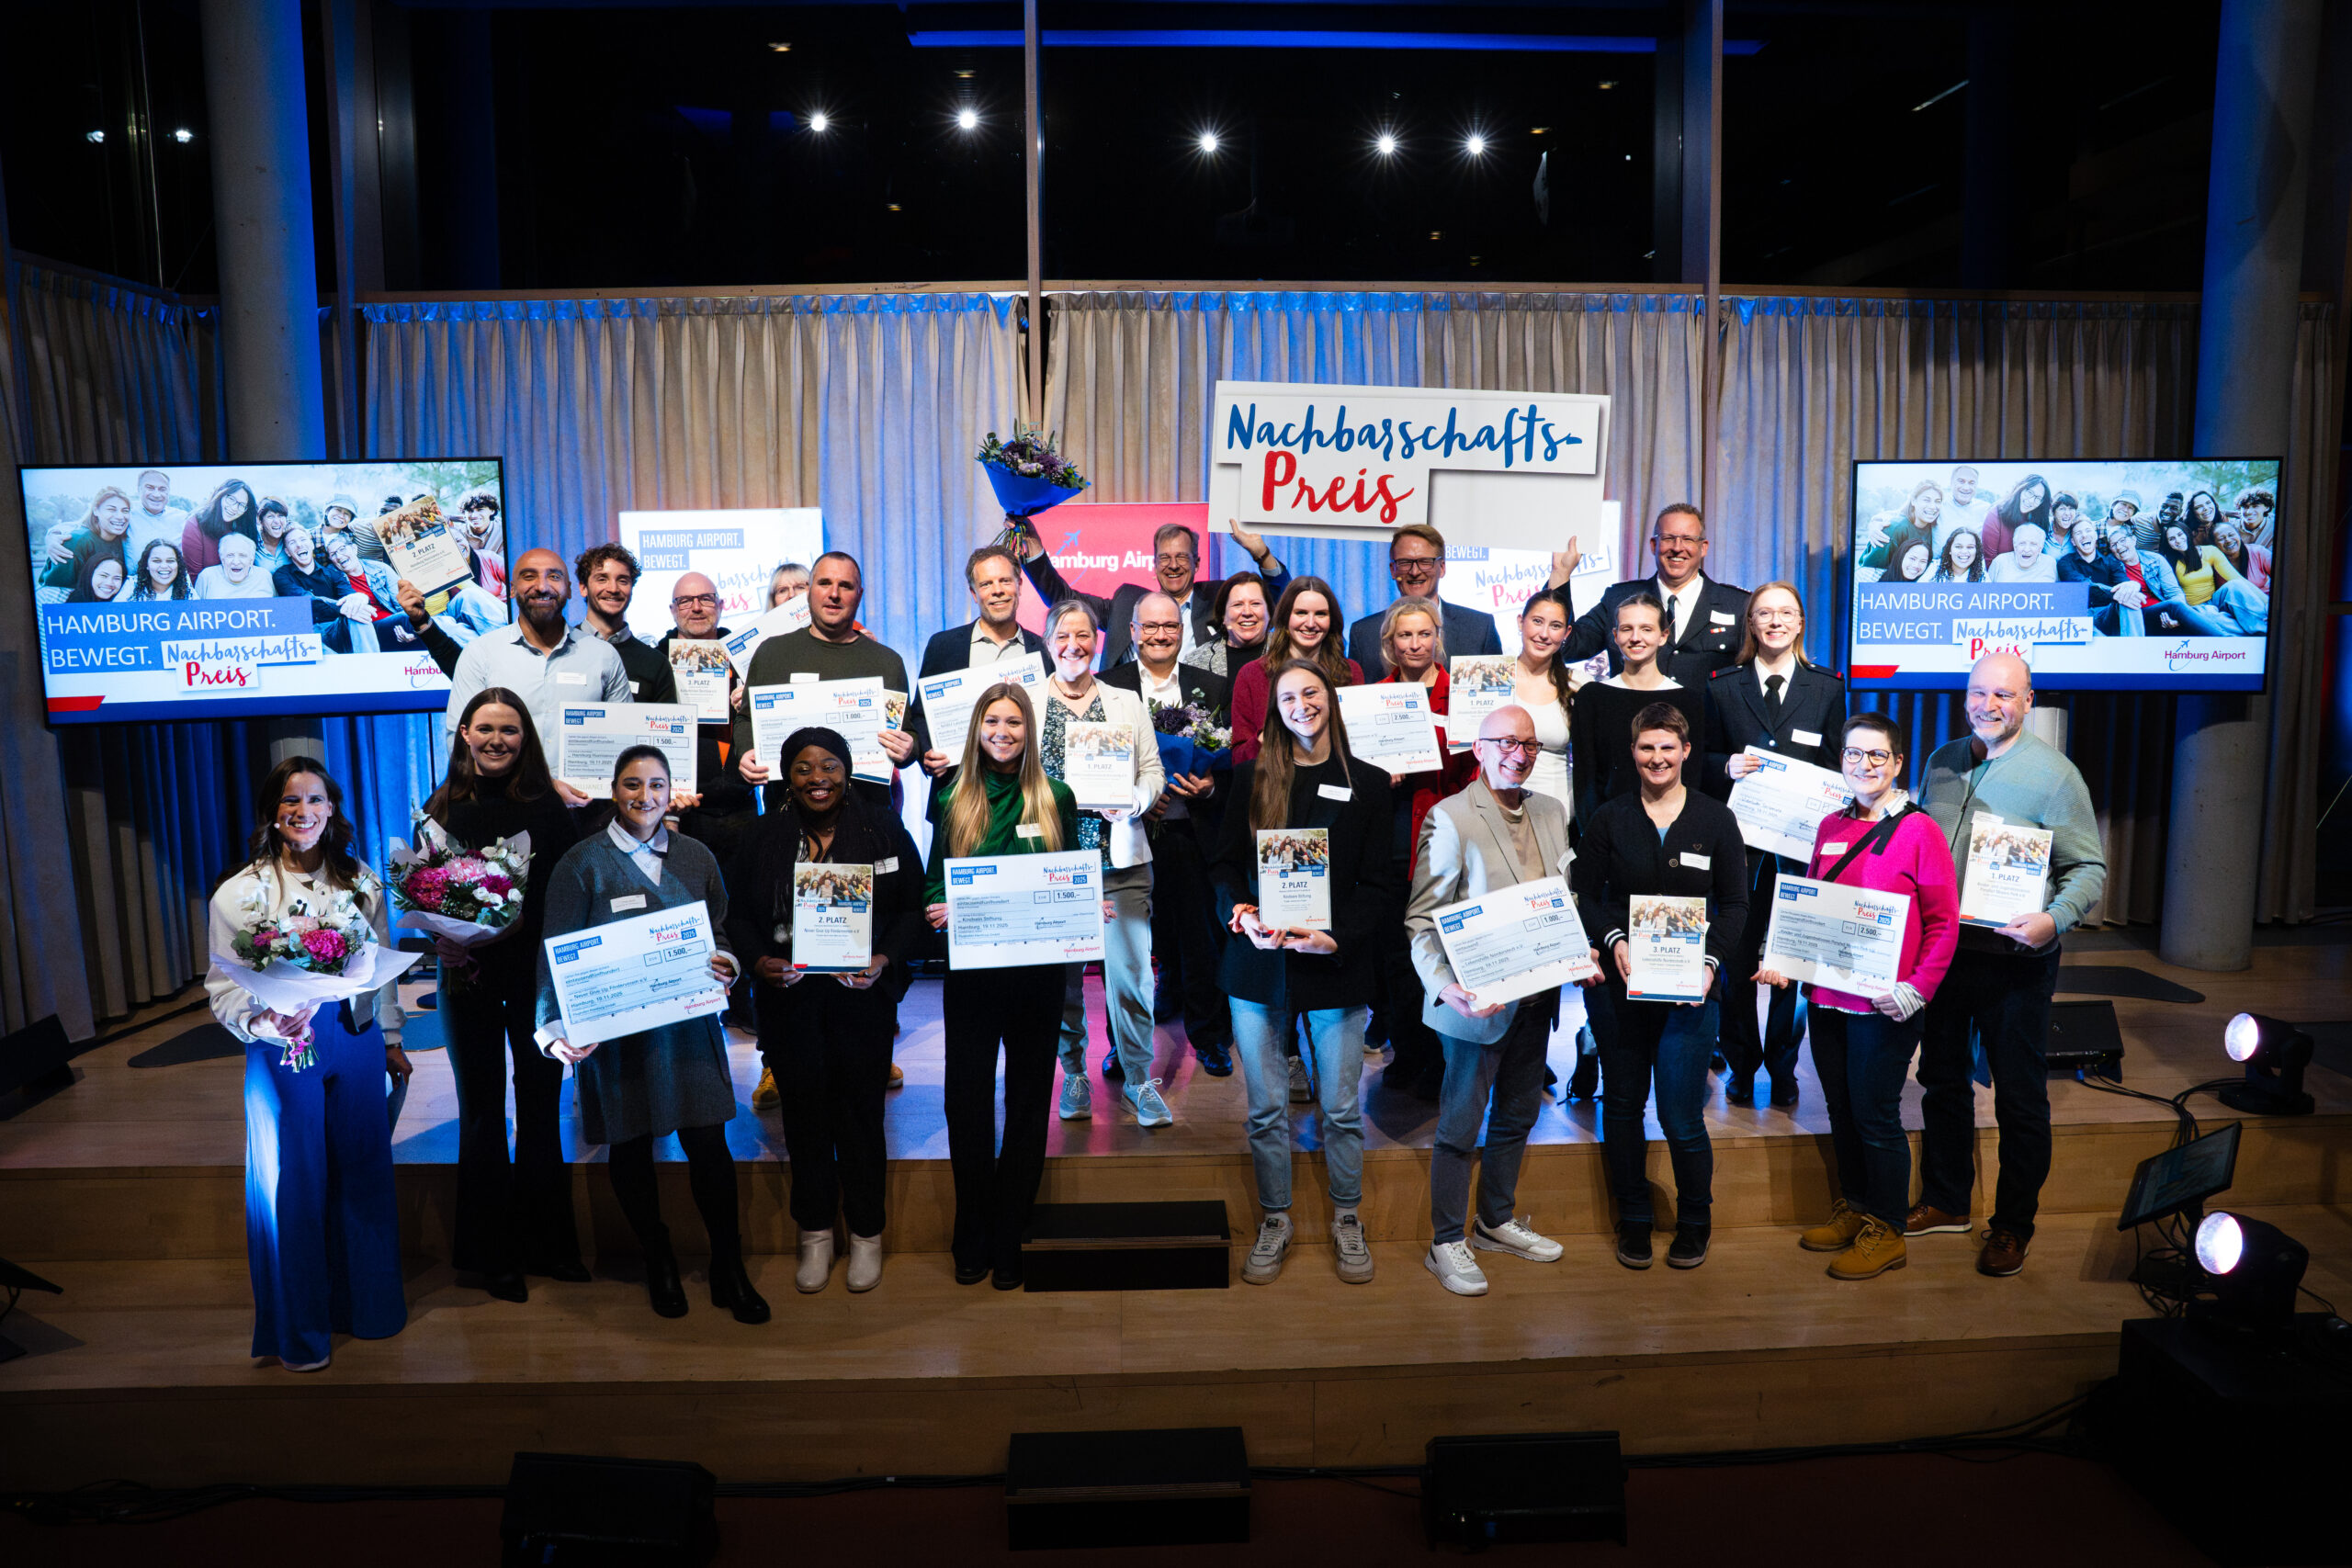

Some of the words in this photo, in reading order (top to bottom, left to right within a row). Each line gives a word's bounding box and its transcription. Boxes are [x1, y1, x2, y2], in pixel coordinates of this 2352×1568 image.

[1227, 402, 1583, 468] Nachbarschafts-
[1261, 450, 1415, 525] Preis
[643, 533, 694, 549] HAMBURG
[696, 531, 741, 548] AIRPORT.
[1445, 545, 1487, 558] BEWEGT.
[644, 553, 687, 570] BEWEGT.
[1123, 550, 1155, 571] Airp
[1860, 592, 1962, 611] HAMBURG
[1968, 592, 2054, 611] AIRPORT.
[47, 612, 171, 635] HAMBURG
[176, 609, 276, 631] AIRPORT.
[1860, 622, 1943, 640] BEWEGT.
[1956, 618, 2088, 641] Nachbarschafts-
[51, 645, 153, 668] BEWEGT.
[167, 635, 317, 663] Nachbarschafts-
[2165, 650, 2209, 661] Hamburg
[2211, 650, 2246, 661] Airport
[186, 661, 252, 687] Preis
[404, 665, 442, 676] Hambu
[925, 682, 944, 693] HAMBURG
[838, 696, 857, 705] Preis
[650, 720, 670, 730] Preis
[952, 867, 975, 875] HAMBURG
[1049, 873, 1071, 882] Preis
[1073, 875, 1086, 884] 2025
[1998, 874, 2020, 882] PLATZ
[1288, 881, 1308, 889] PLATZ
[1781, 883, 1801, 893] HAMBURG
[1532, 898, 1550, 908] Preis
[819, 916, 825, 924] 2.
[826, 916, 847, 924] PLATZ
[1442, 912, 1463, 925] HAMBURG
[1858, 907, 1876, 919] Preis
[1879, 916, 1892, 925] 2025
[656, 931, 679, 942] Preis
[682, 930, 695, 941] 2025
[554, 942, 580, 954] HAMBURG
[1660, 946, 1681, 954] PLATZ
[684, 1000, 706, 1011] Hamburg
[705, 997, 721, 1007] Airport
